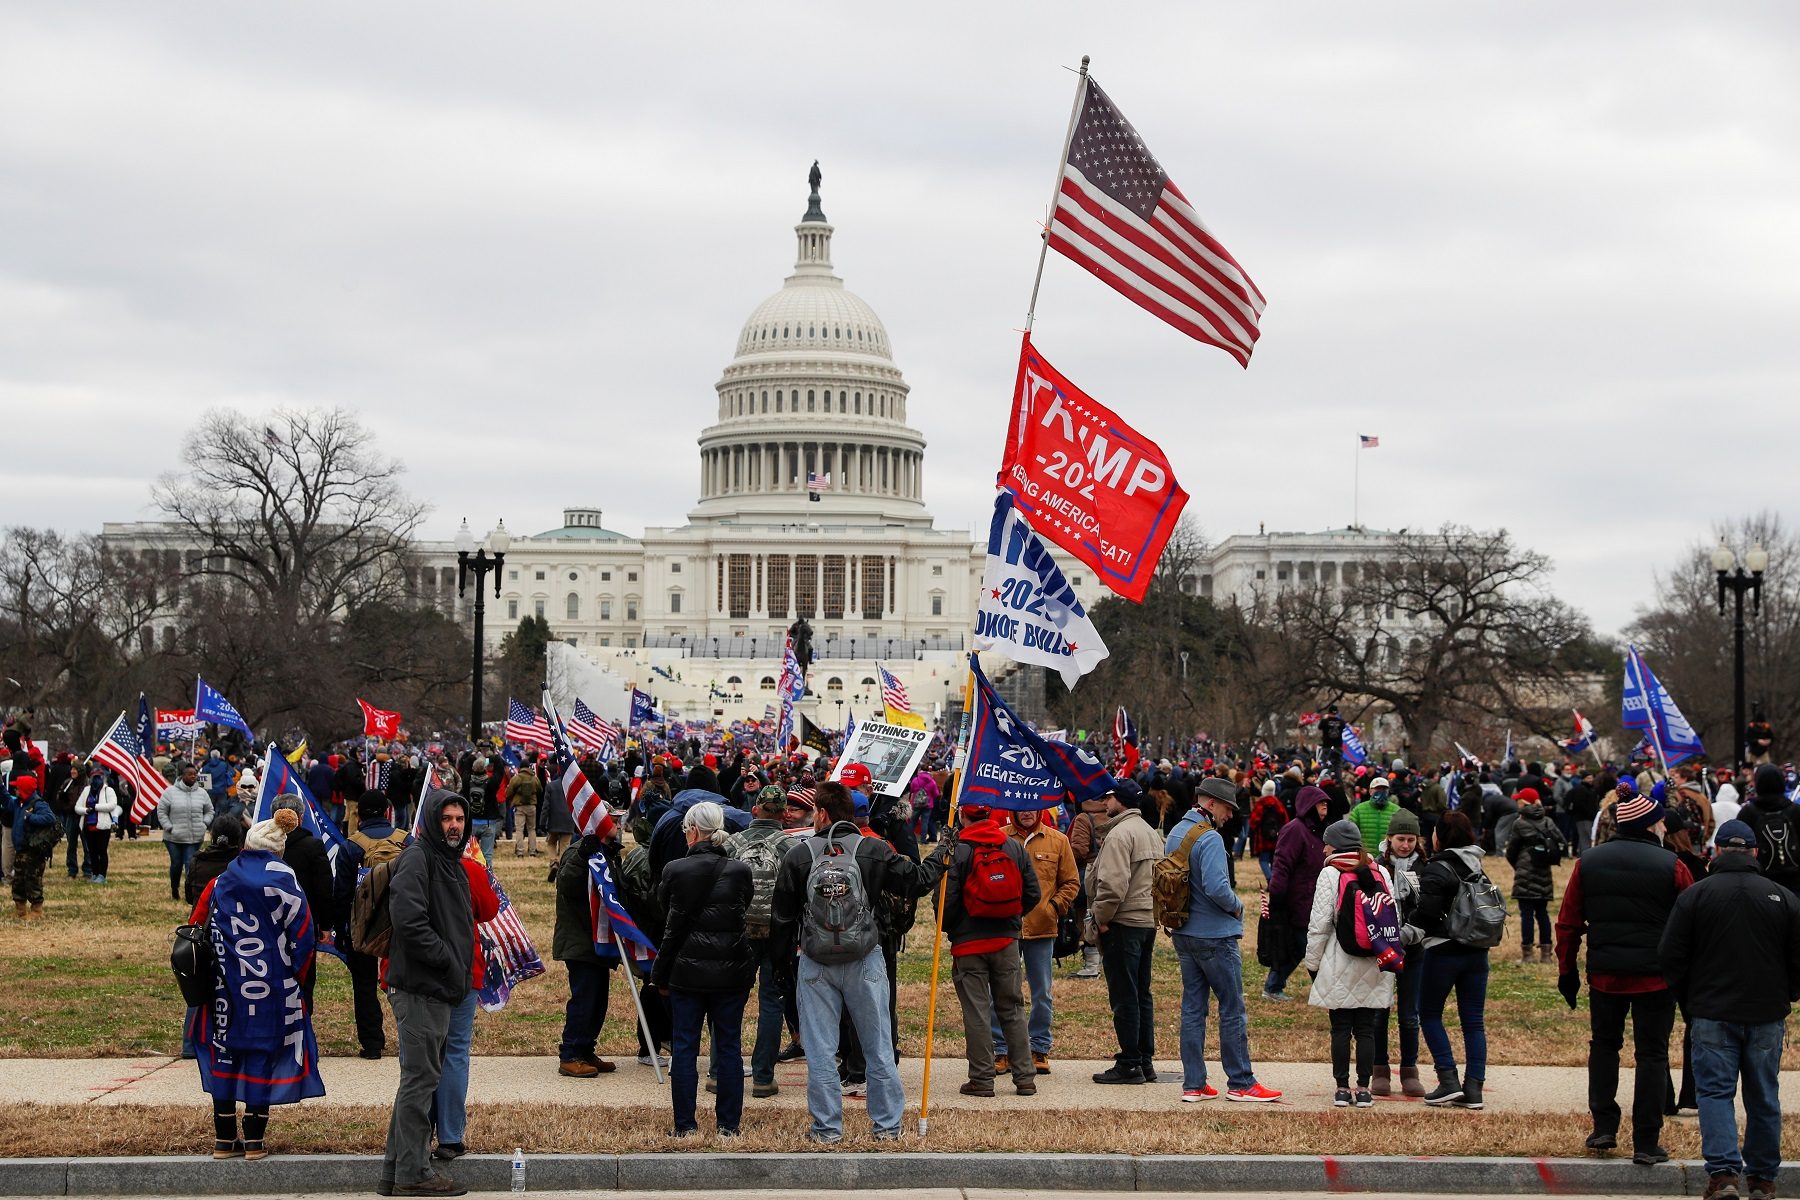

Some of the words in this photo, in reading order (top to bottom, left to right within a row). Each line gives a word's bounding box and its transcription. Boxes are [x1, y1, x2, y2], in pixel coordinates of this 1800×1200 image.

[1039, 490, 1101, 537] AMERICA
[861, 722, 910, 739] NOTHING
[911, 730, 926, 742] TO
[230, 901, 271, 1016] -2020-
